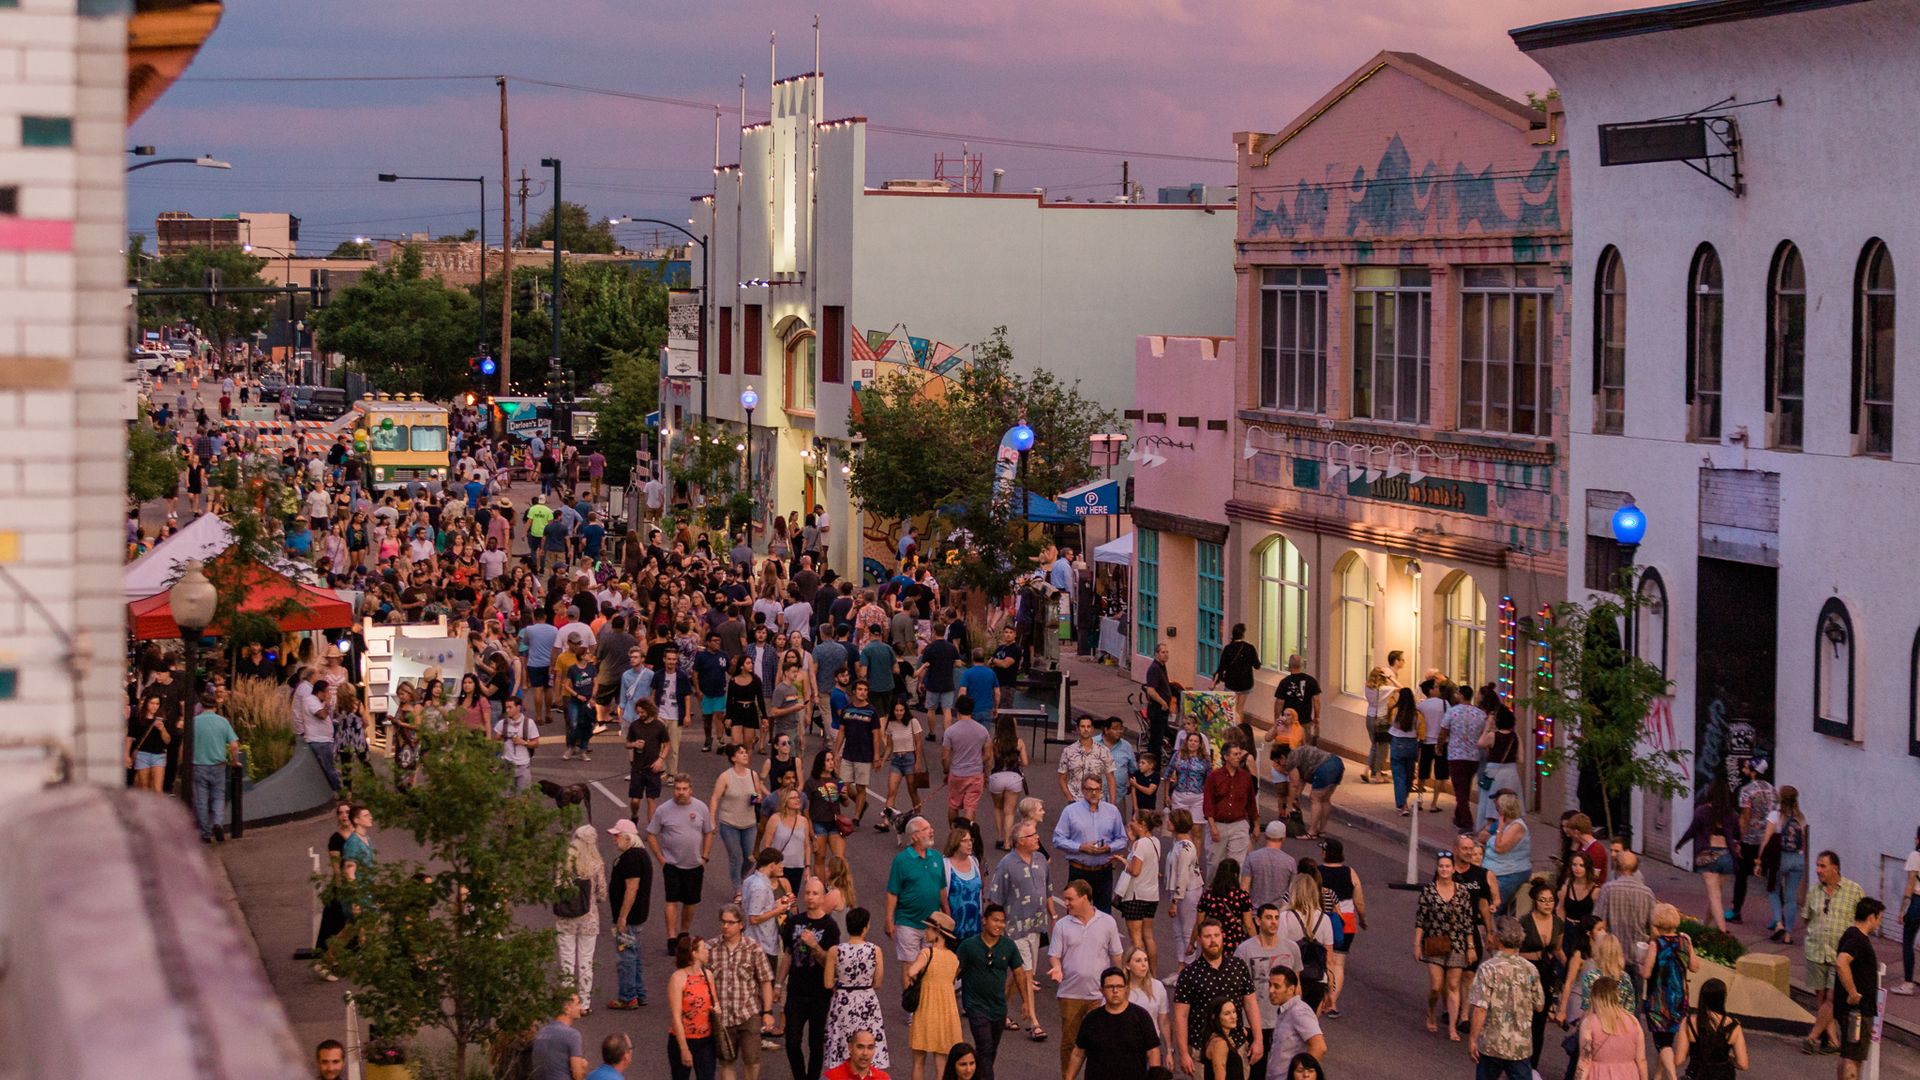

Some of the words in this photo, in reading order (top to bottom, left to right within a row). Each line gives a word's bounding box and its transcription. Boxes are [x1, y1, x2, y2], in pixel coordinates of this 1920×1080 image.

[1409, 485, 1421, 503] on
[1422, 480, 1450, 506] Santa
[1075, 506, 1088, 515] PAY
[1089, 505, 1108, 514] HERE
